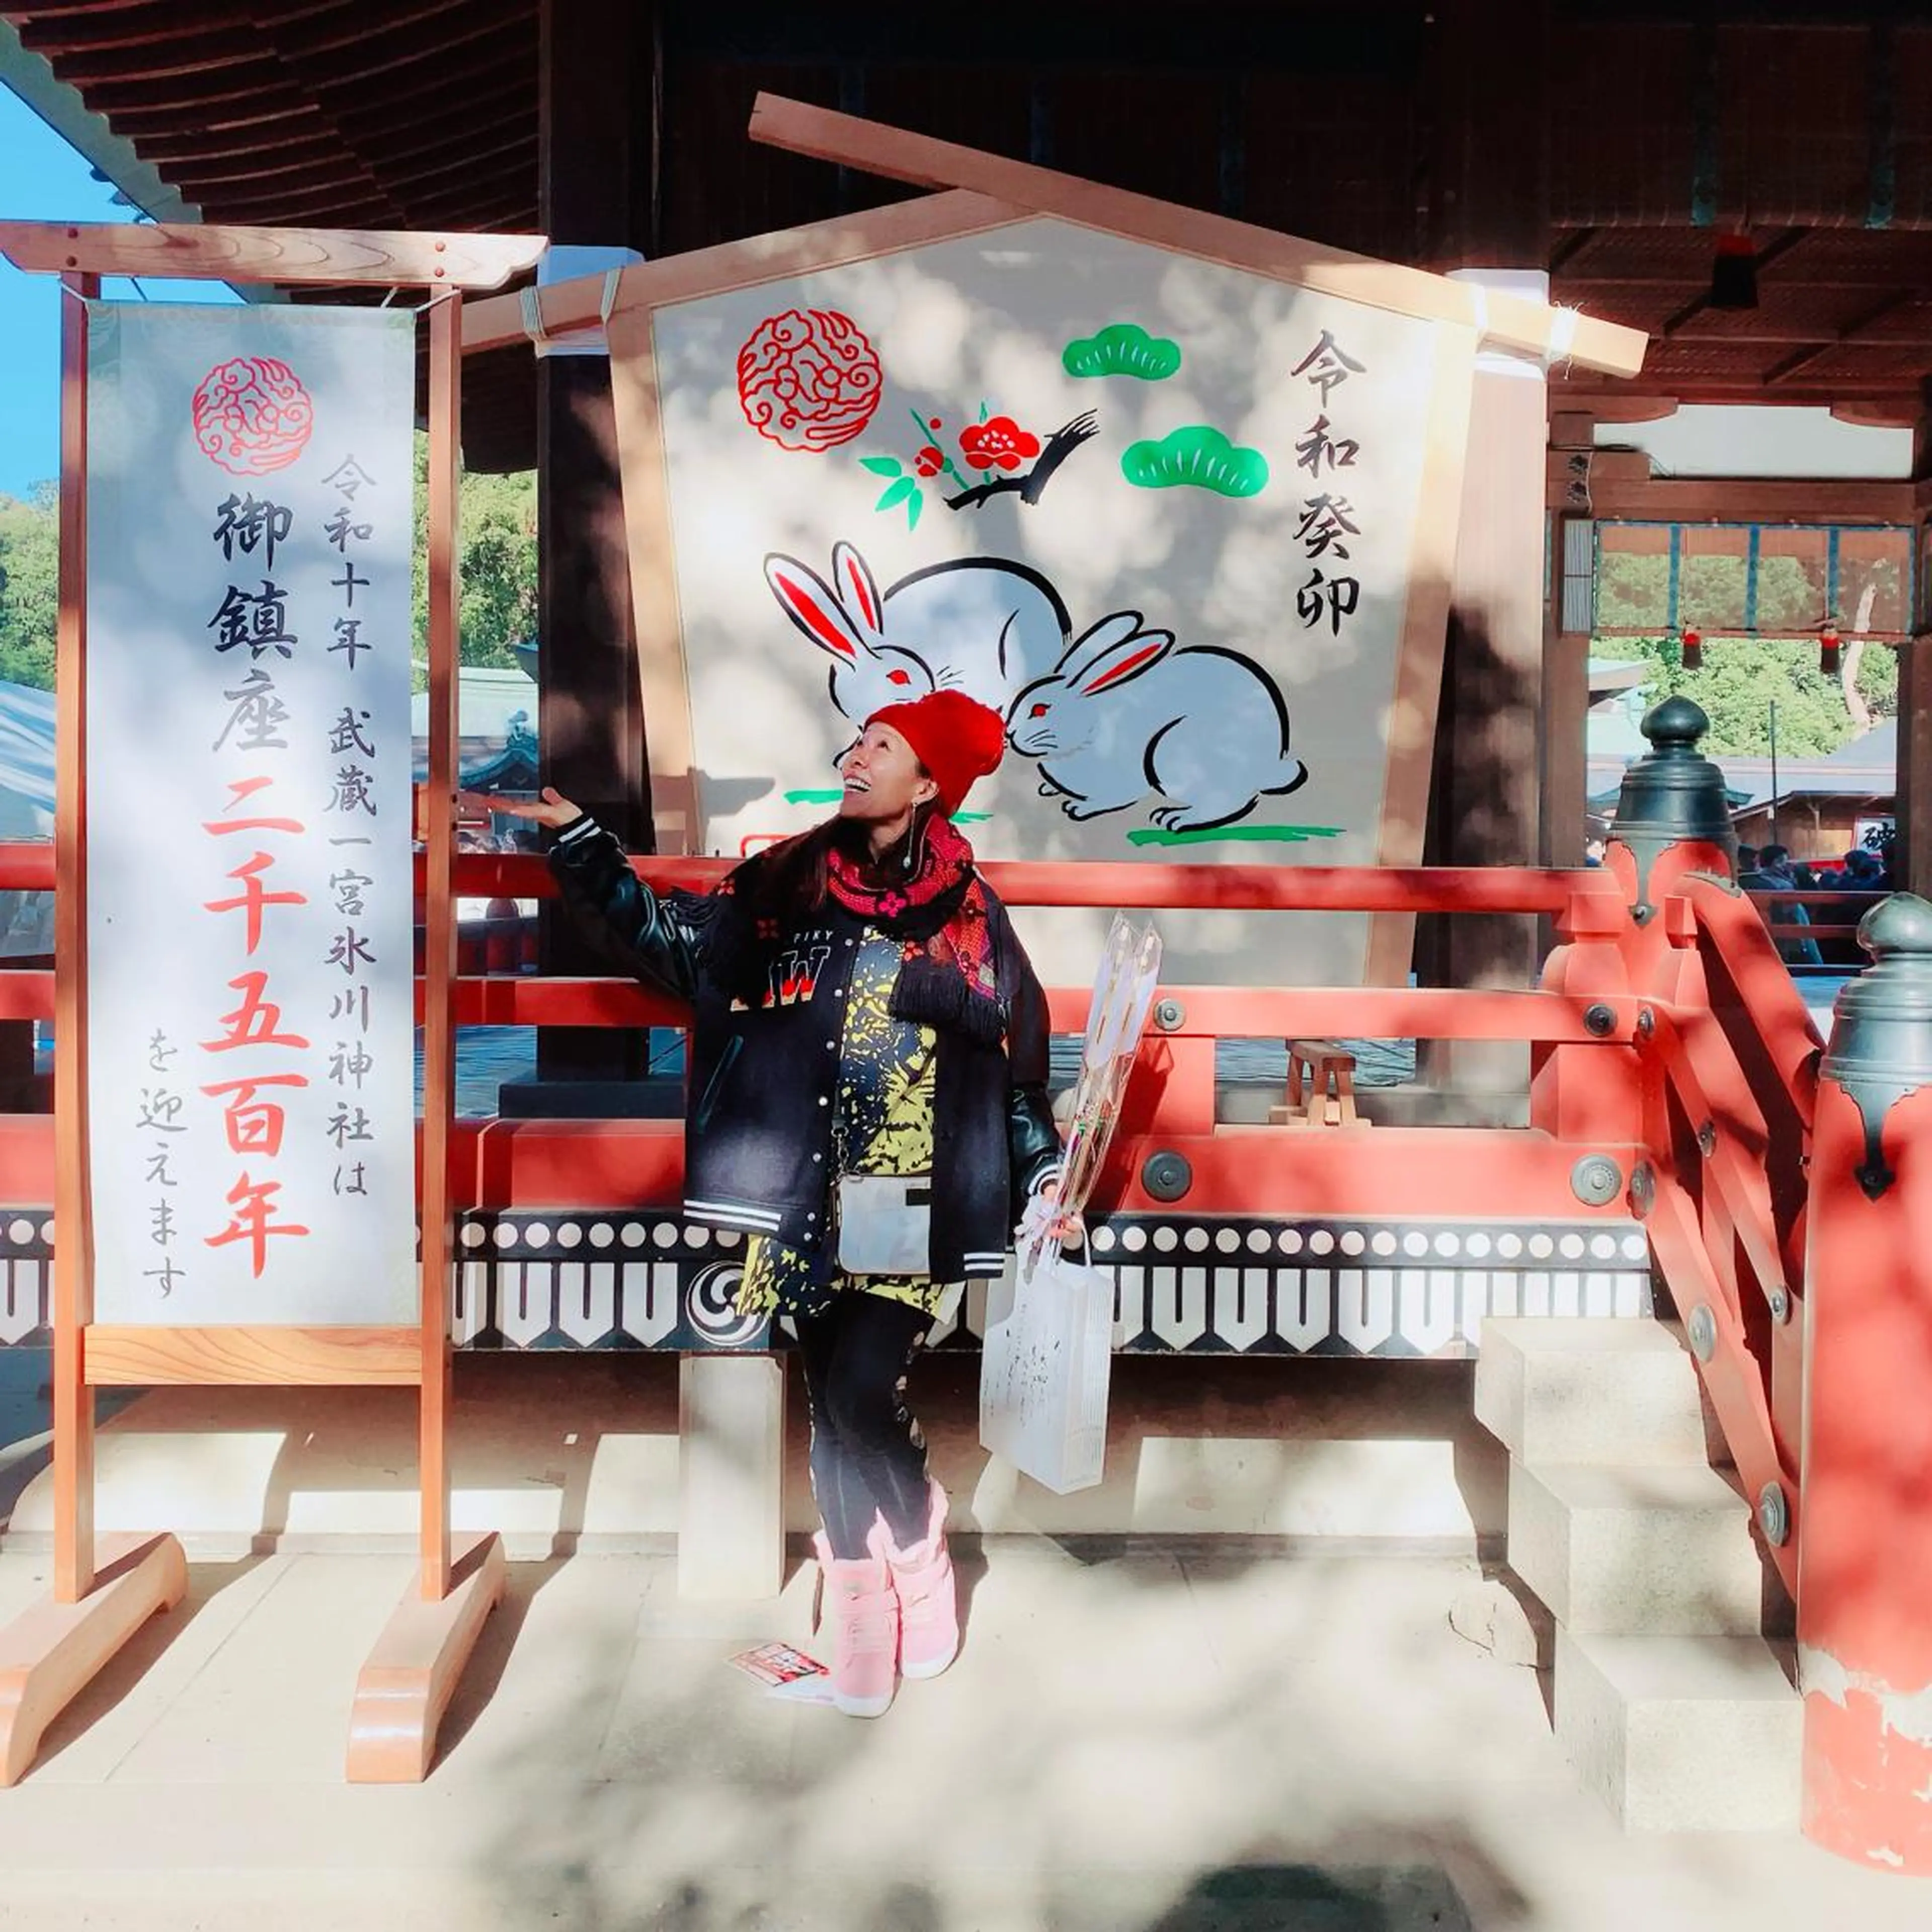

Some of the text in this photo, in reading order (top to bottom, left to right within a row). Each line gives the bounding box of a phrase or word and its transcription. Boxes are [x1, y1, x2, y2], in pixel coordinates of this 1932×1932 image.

[1291, 329, 1367, 637] 令和癸卯
[197, 492, 311, 1279] 御鎮座二千五百年
[320, 453, 377, 1196] 令和十年 武蔵一宮氷川神社は
[135, 1028, 188, 1299] を迎えます
